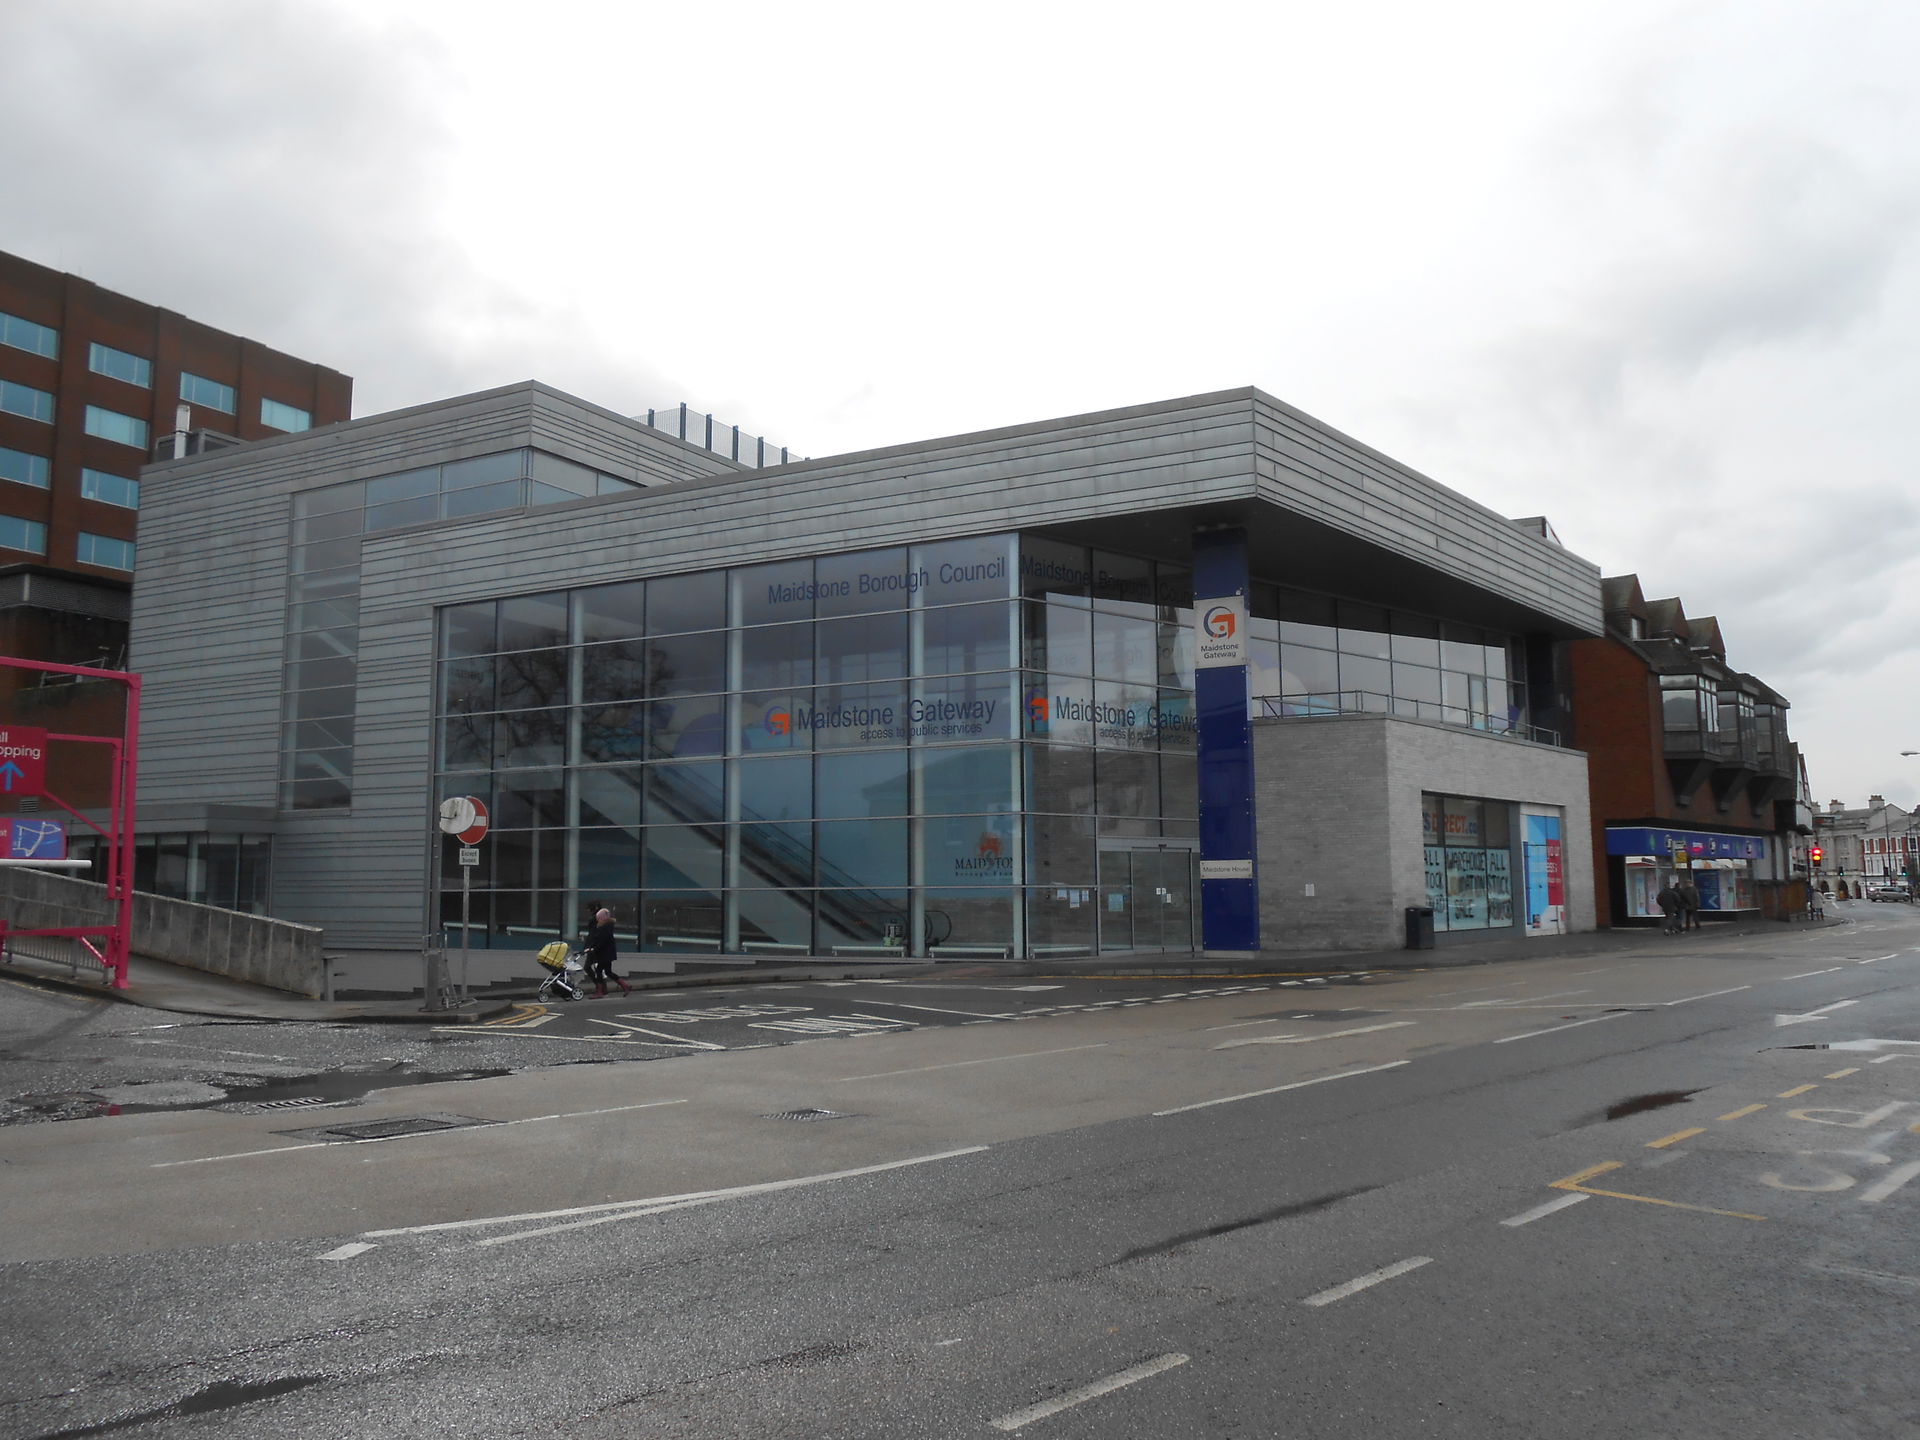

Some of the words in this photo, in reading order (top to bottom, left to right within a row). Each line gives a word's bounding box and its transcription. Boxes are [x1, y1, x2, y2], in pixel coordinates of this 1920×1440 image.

[1021, 554, 1090, 586] Maidstone
[768, 580, 850, 605] Maidstone
[859, 567, 929, 594] Borough
[939, 556, 1005, 584] Council
[1200, 643, 1238, 652] Maidstone
[1203, 651, 1237, 659] Gateway
[798, 704, 893, 731] Maidstone
[907, 698, 996, 725] Gateway
[1056, 695, 1136, 727] Maidstone
[1147, 705, 1197, 732] Gatewa
[0, 731, 8, 743] ll
[860, 727, 893, 740] access
[896, 726, 906, 738] to
[908, 723, 938, 737] public
[941, 721, 982, 735] services
[1099, 728, 1126, 739] access
[1490, 852, 1506, 872] ALL
